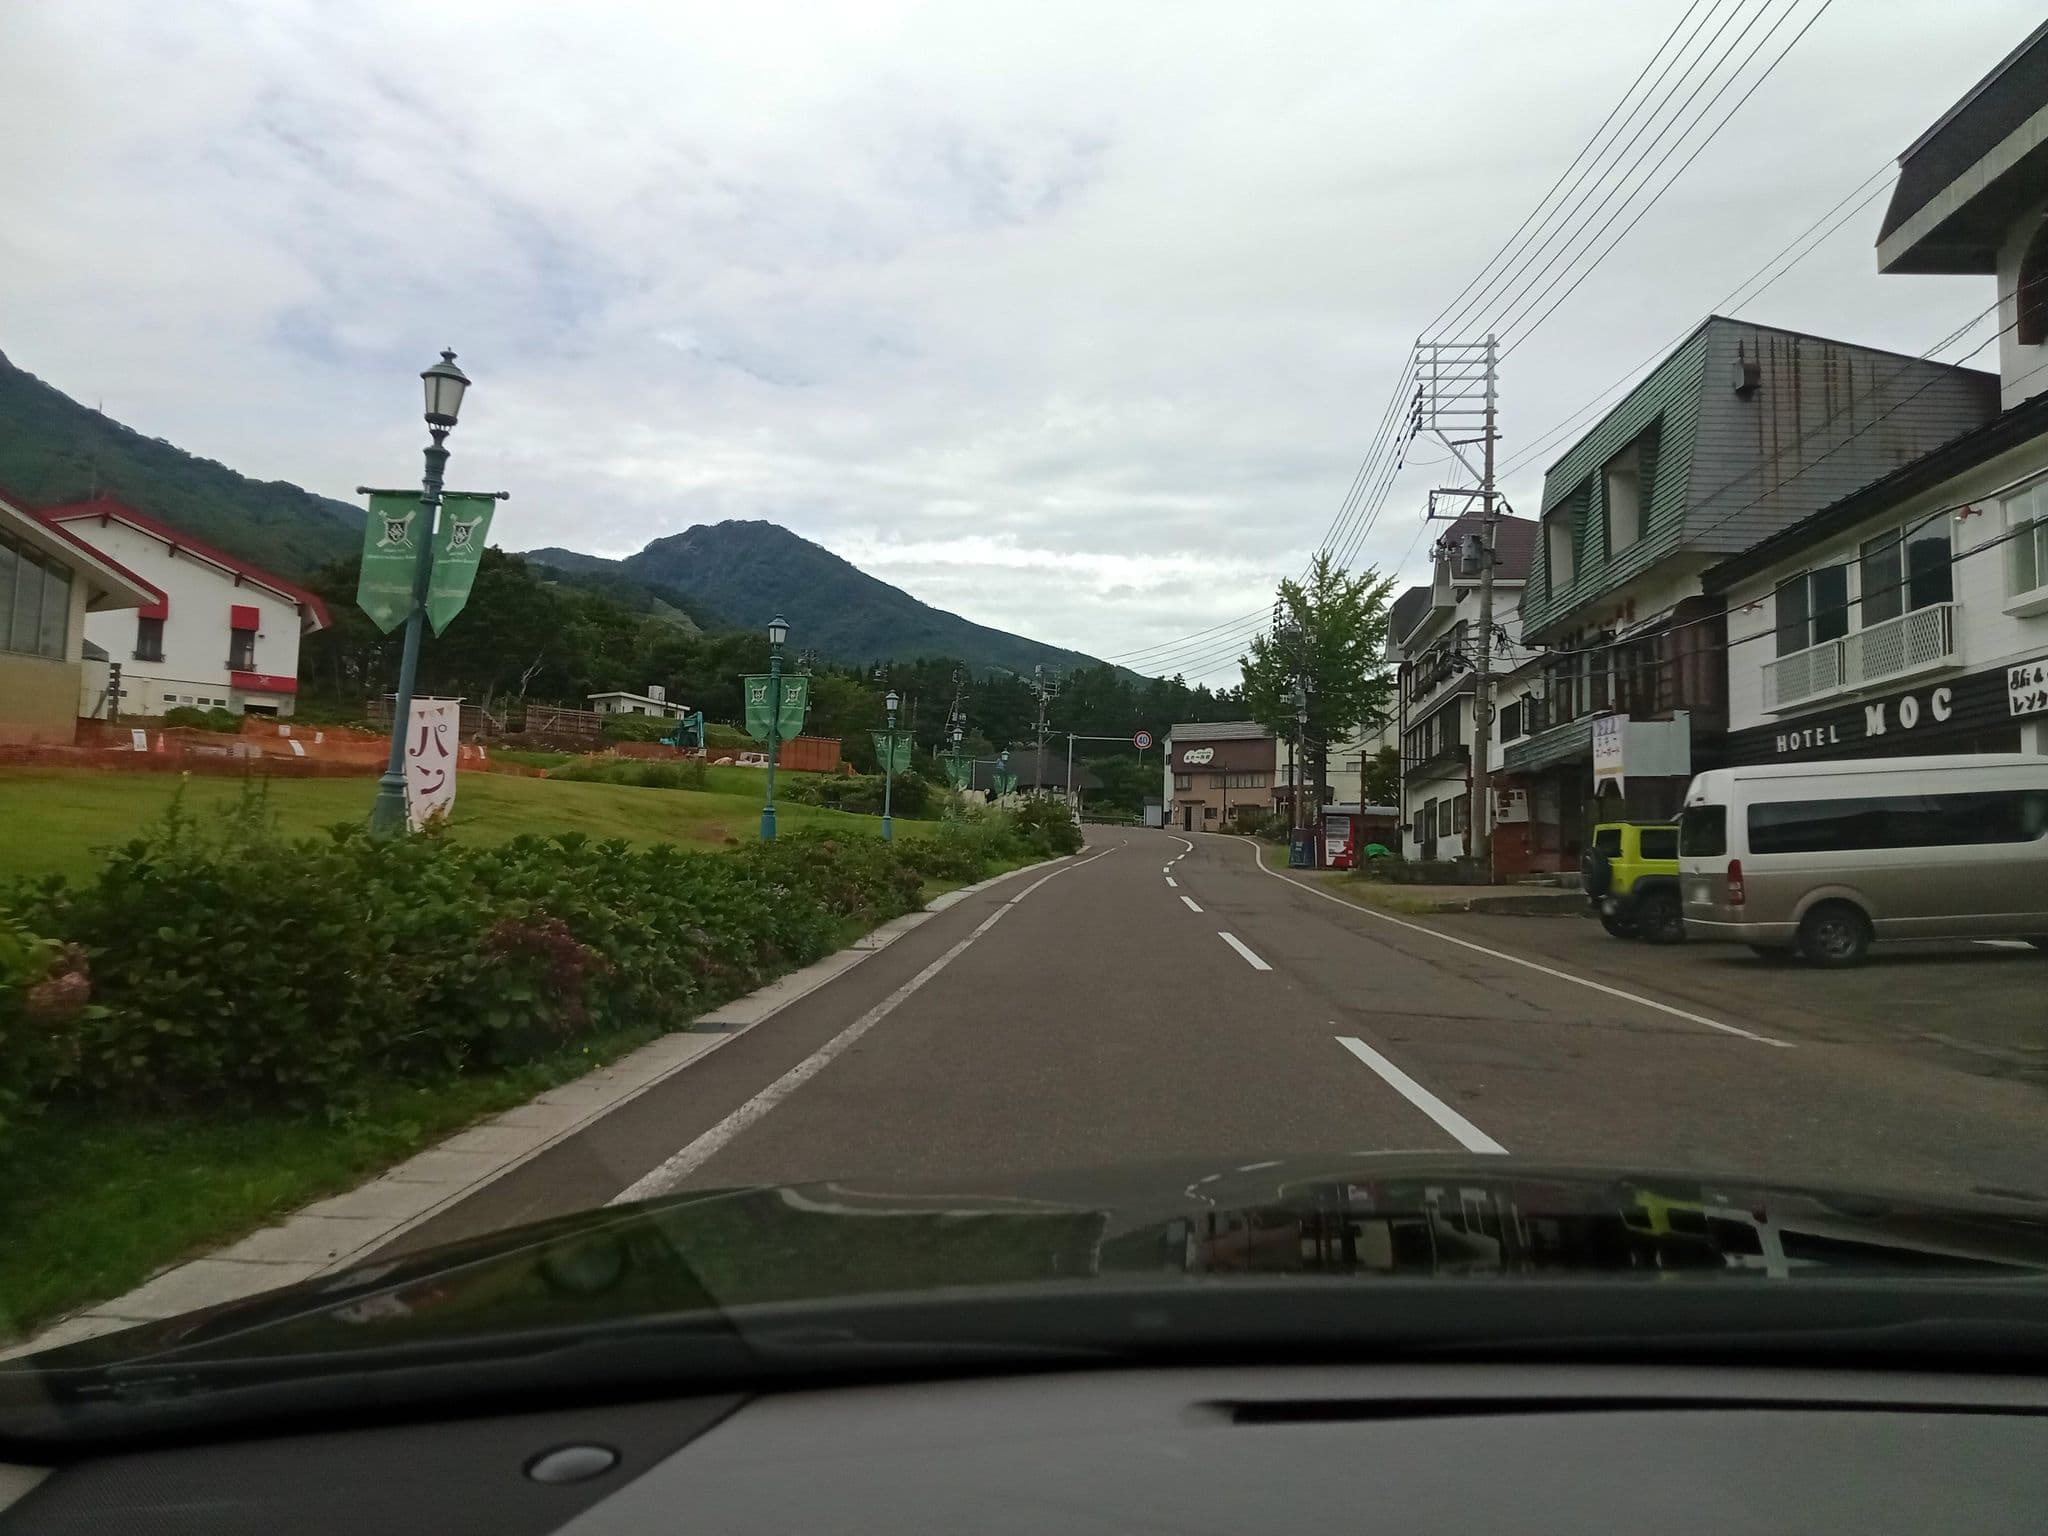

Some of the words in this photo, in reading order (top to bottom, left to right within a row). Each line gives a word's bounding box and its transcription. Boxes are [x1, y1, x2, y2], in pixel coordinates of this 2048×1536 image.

[1138, 735, 1148, 745] 40
[1777, 725, 1840, 753] HOTEL
[1865, 688, 1952, 737] MOC
[409, 725, 449, 795] パン
